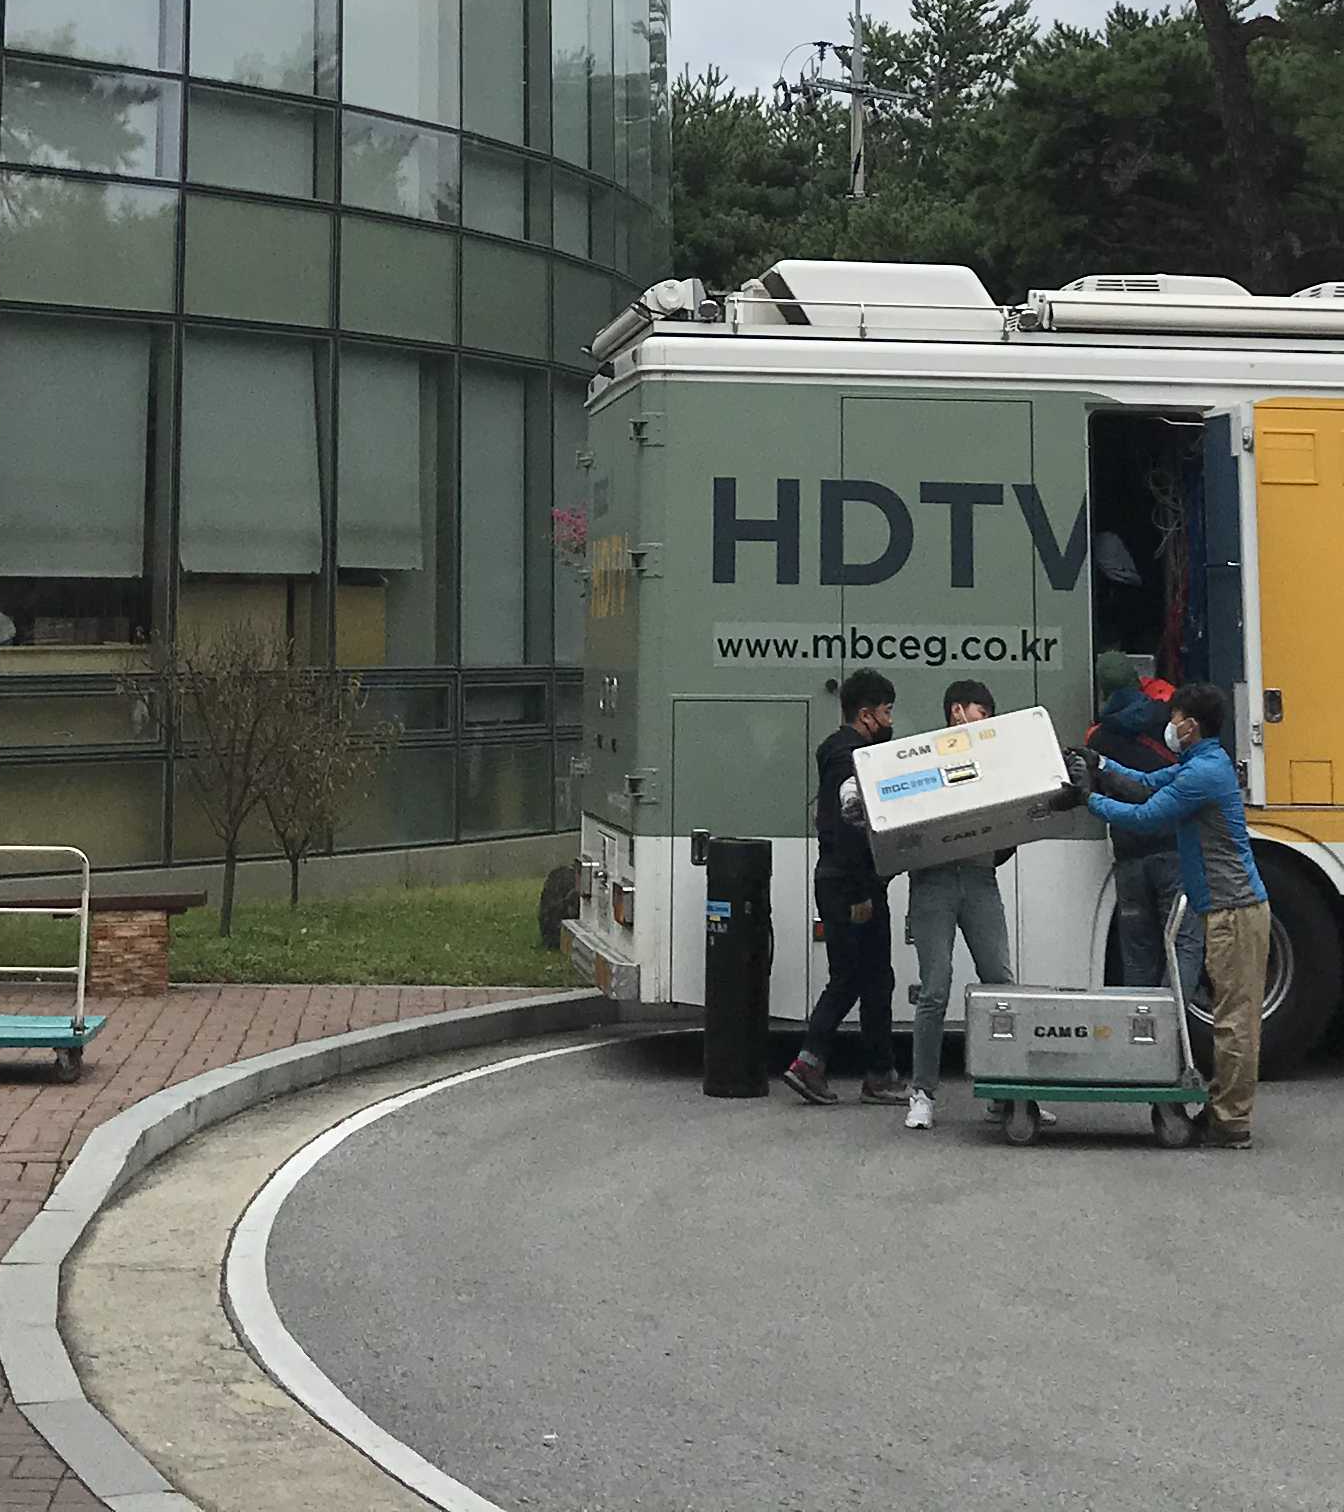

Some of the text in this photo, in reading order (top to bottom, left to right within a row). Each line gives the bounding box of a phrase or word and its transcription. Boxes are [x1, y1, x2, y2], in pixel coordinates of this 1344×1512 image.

[712, 477, 1088, 592] HDTV
[716, 626, 1059, 667] www.mbceg.co.kr
[896, 744, 933, 760] CAM
[941, 829, 977, 843] CAM
[1033, 1025, 1072, 1038] CAM
